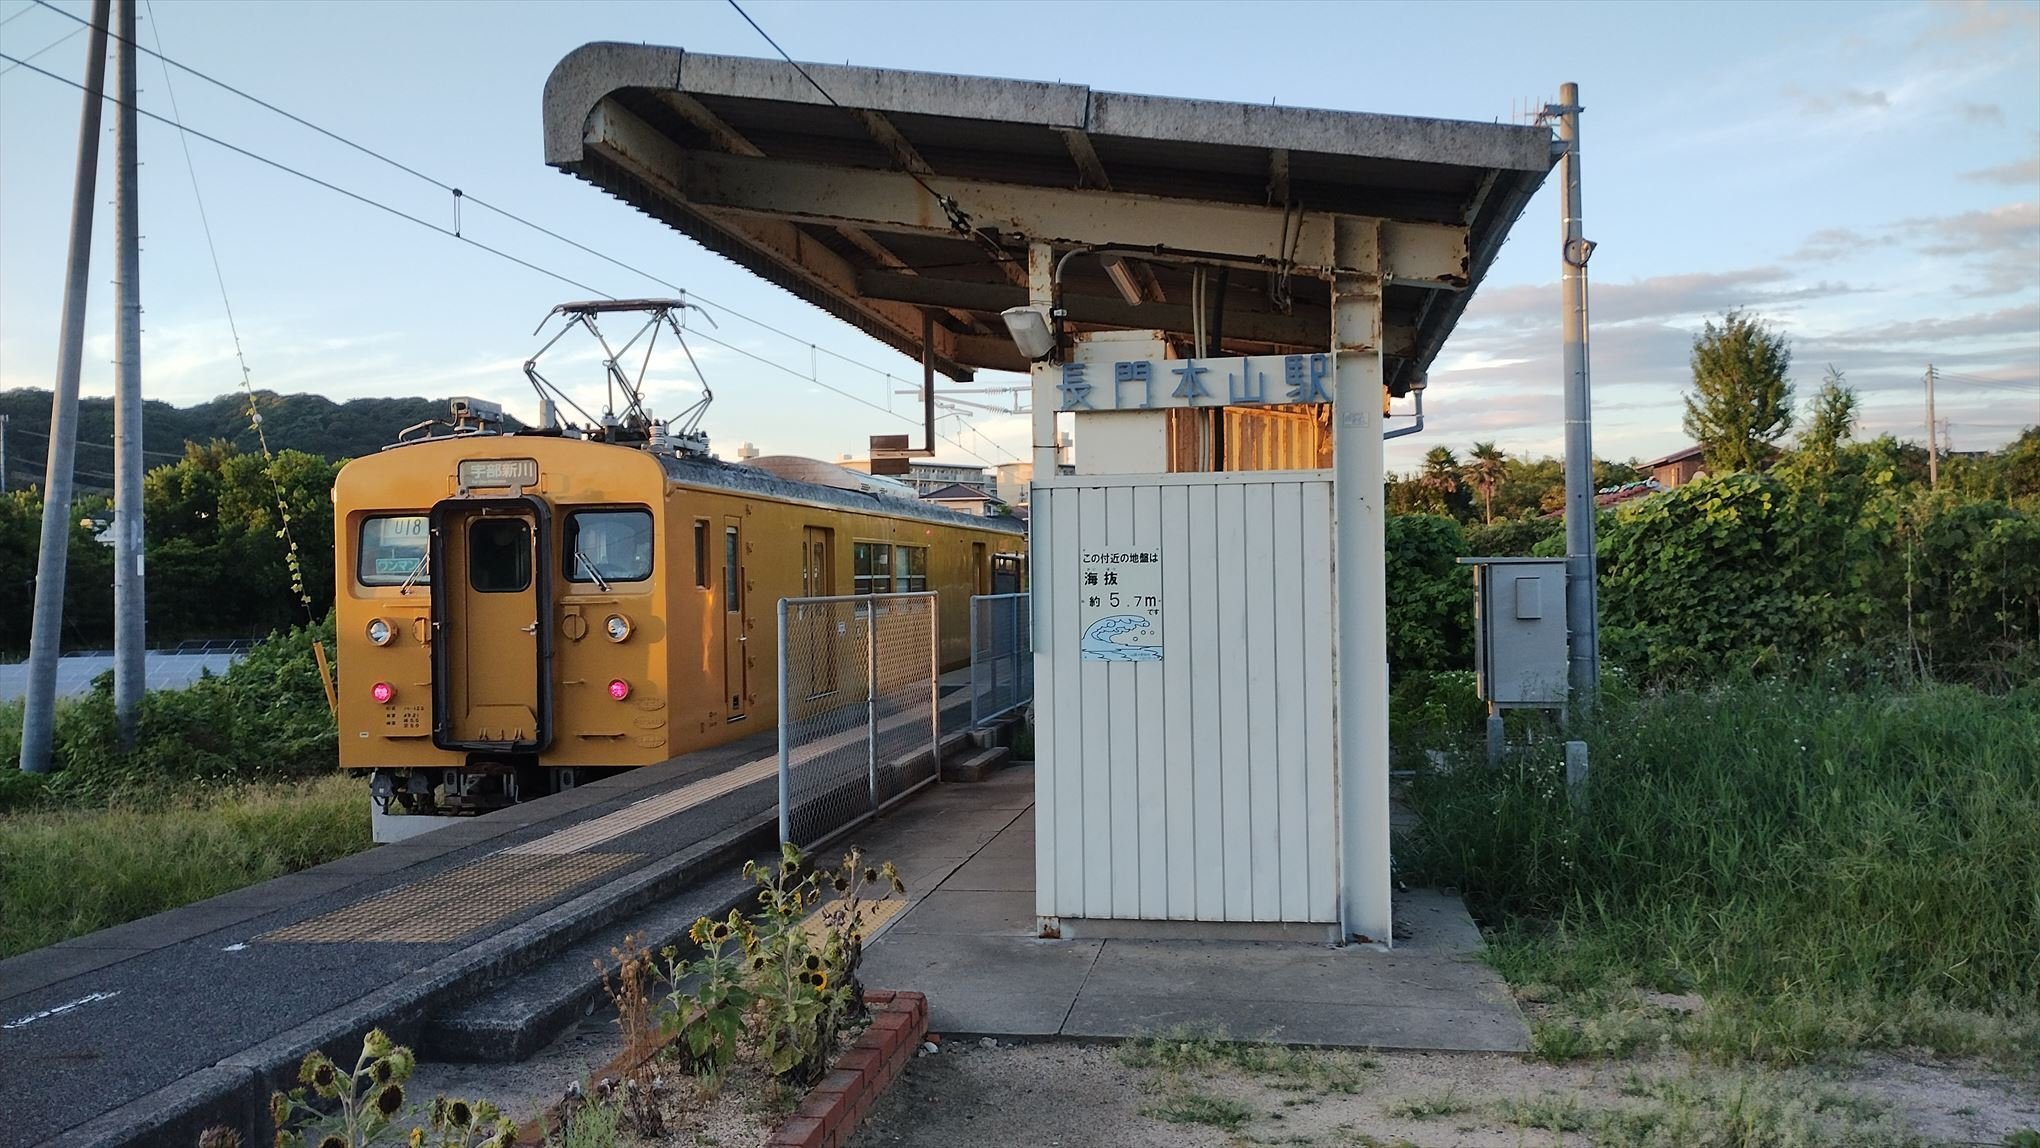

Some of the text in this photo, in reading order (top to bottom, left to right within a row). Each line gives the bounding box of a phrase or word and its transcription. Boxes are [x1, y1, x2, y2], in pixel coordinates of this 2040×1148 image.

[1056, 354, 1331, 410] 長門本山駅
[470, 462, 533, 479] 宇部新川
[1083, 553, 1158, 564] この付近の地盤は
[1084, 571, 1118, 586] 海抜
